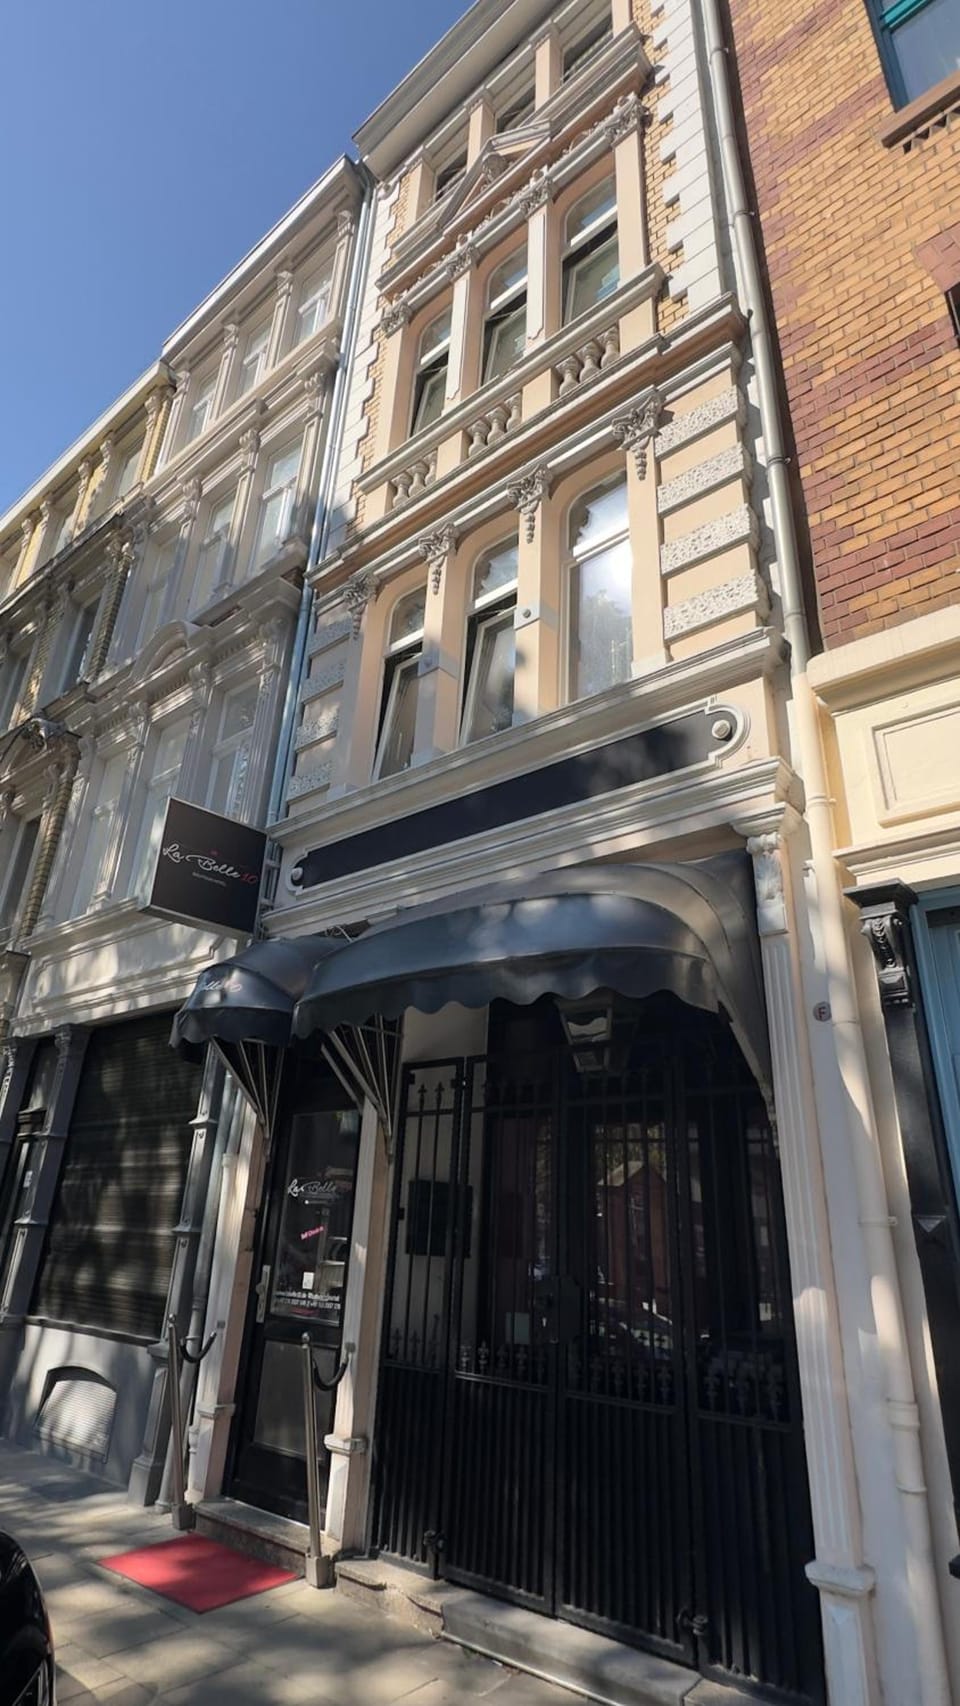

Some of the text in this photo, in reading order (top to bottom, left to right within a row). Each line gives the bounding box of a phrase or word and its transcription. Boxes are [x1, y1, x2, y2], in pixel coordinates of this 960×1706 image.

[163, 843, 185, 863] La
[185, 854, 240, 878] Belle
[287, 1178, 304, 1197] La
[303, 1181, 336, 1194] Belle
